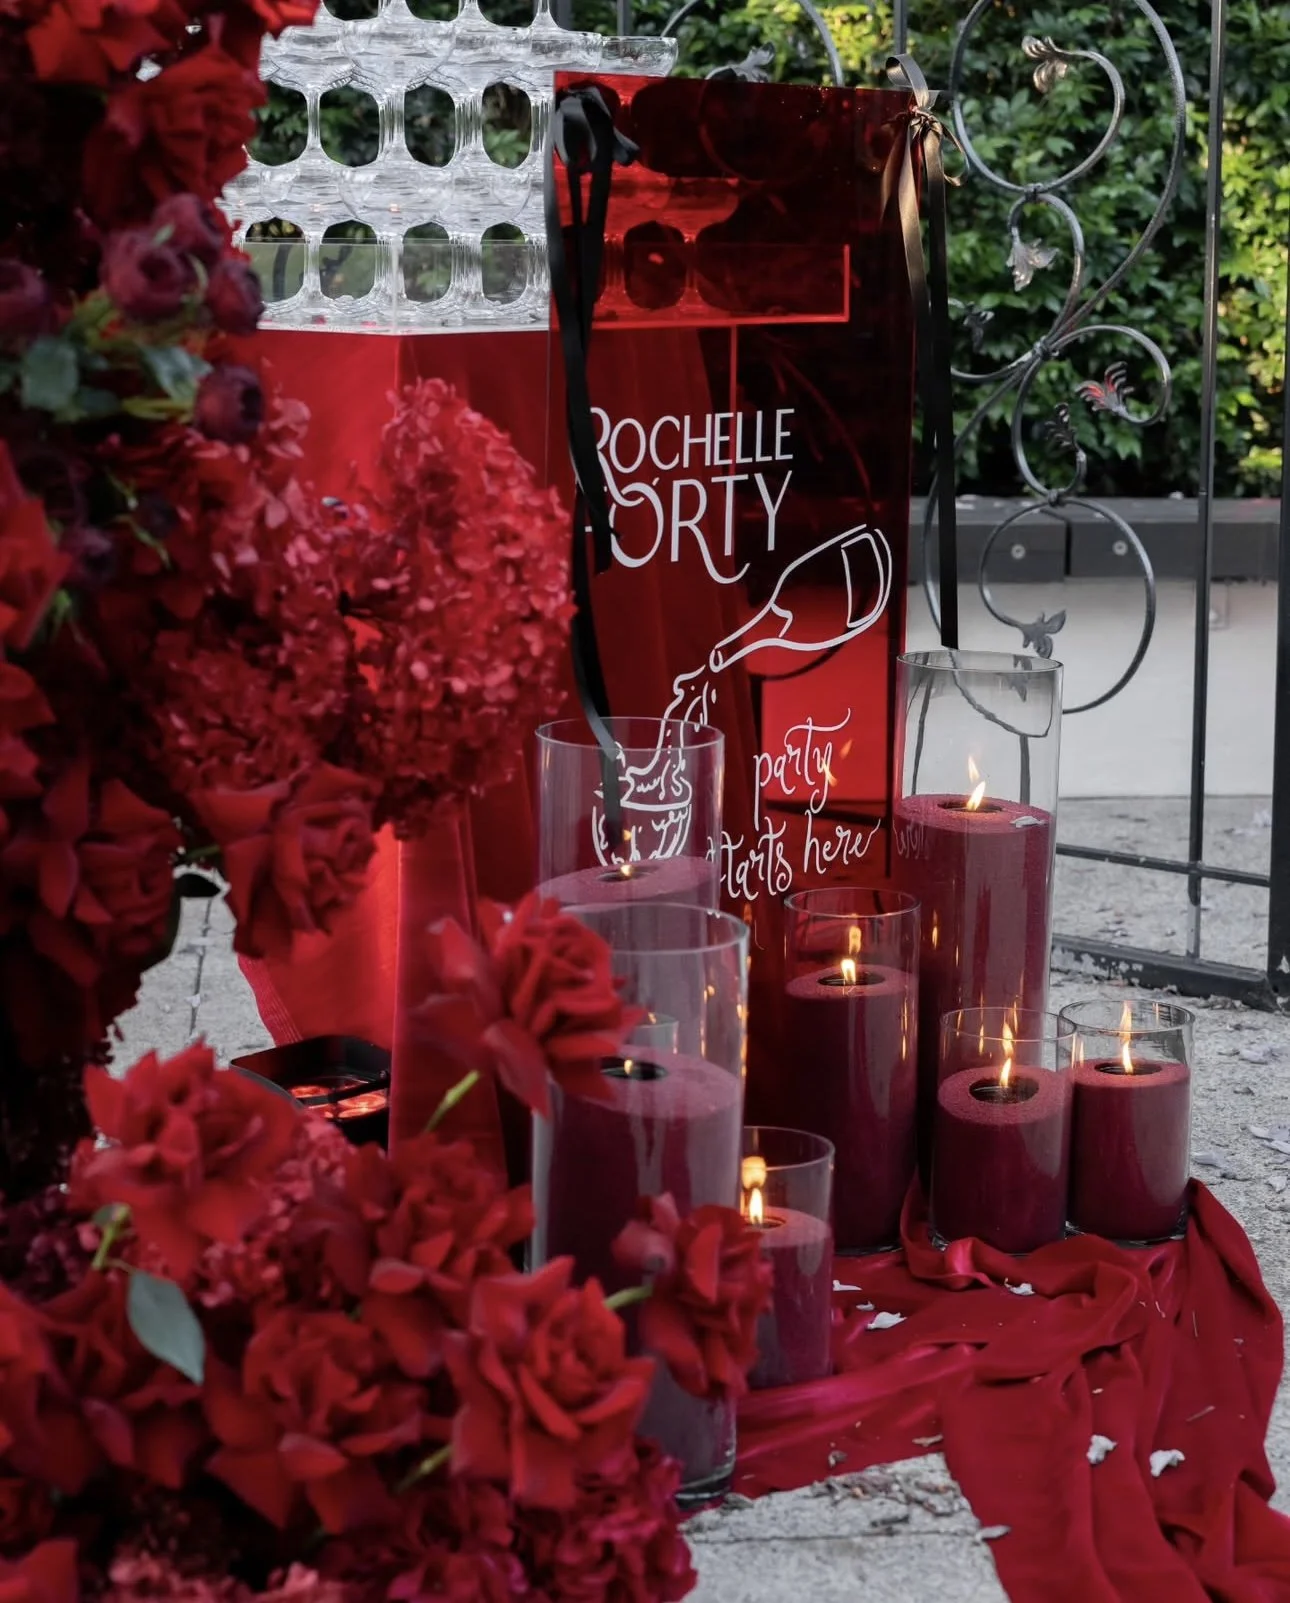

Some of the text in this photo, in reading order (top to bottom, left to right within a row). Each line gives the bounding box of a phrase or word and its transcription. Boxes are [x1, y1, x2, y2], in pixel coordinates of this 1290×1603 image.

[590, 406, 795, 507] ROCHELLE
[584, 470, 793, 585] ORTY
[753, 707, 851, 831] party
[719, 816, 793, 901] tarts
[803, 809, 881, 875] here
